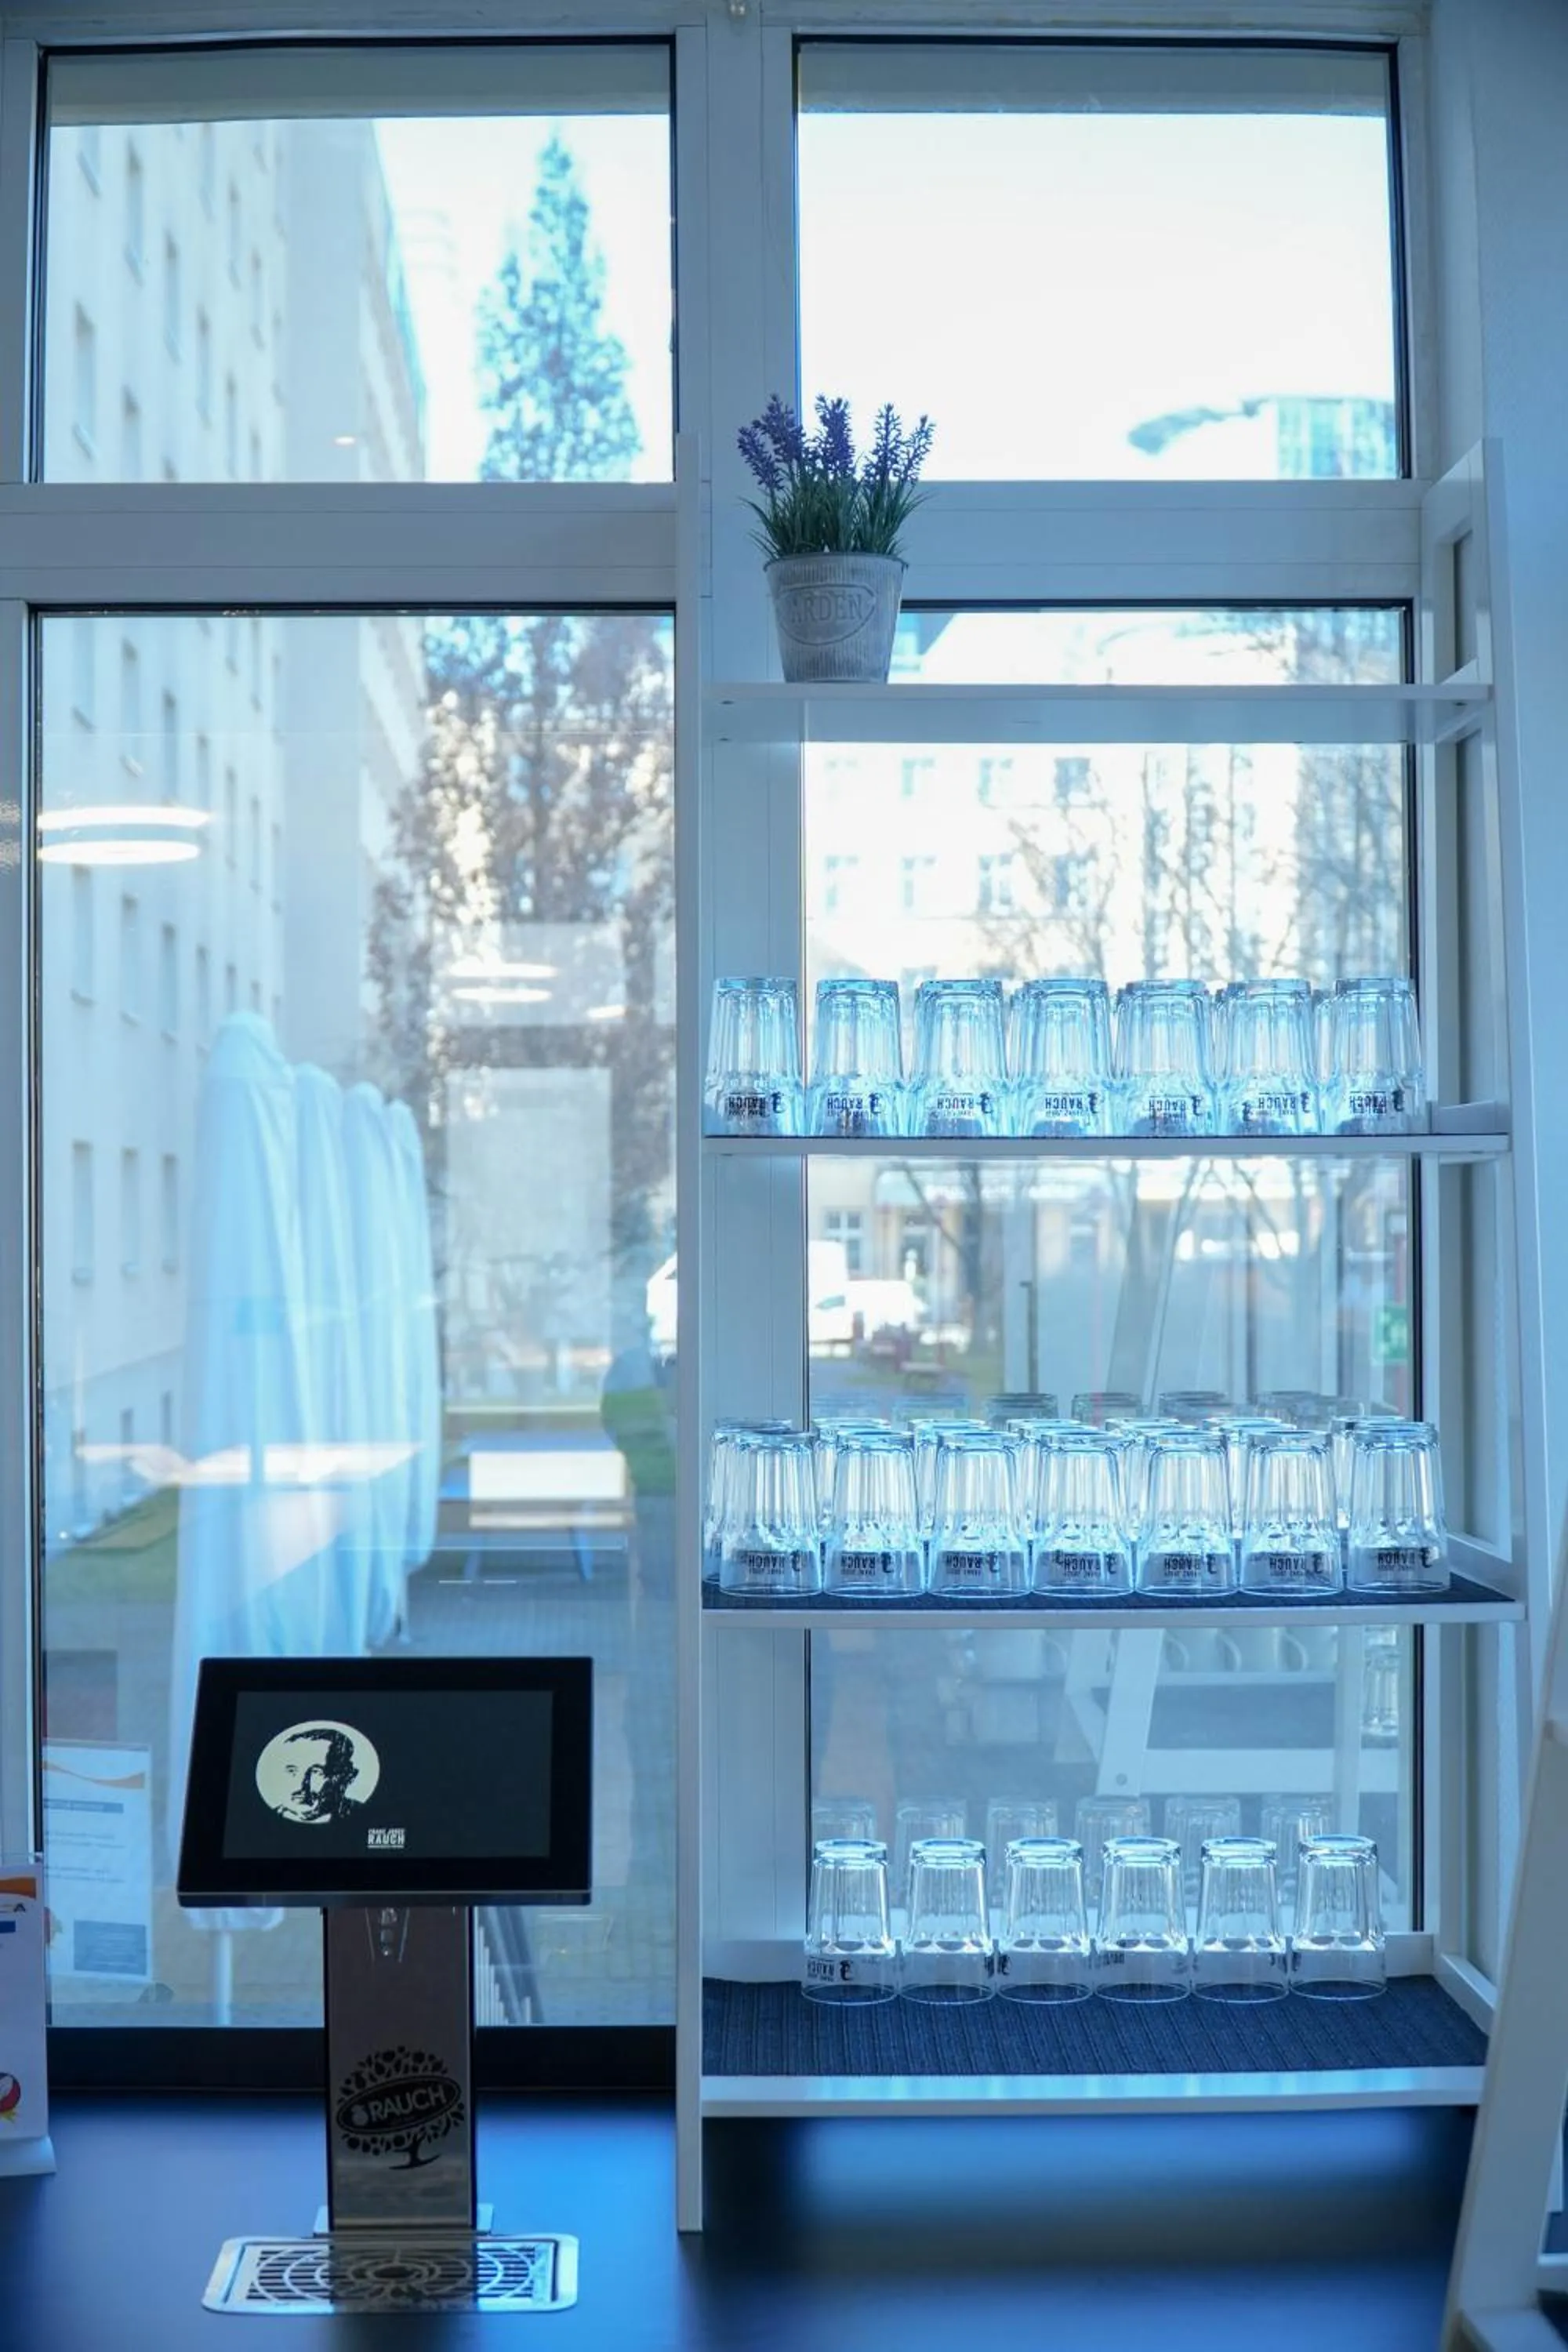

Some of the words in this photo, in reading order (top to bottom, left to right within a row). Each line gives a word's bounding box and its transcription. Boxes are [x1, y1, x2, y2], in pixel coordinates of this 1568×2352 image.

[779, 592, 863, 623] ARDEN
[827, 1098, 863, 1109] RAUCH
[937, 1098, 975, 1109] RAUCH
[1045, 1098, 1083, 1109] RAUCH
[1149, 1099, 1186, 1112] RAUCH
[1258, 1097, 1296, 1109] RAUCH
[841, 1556, 876, 1569] RAUCH
[946, 1555, 981, 1569] RAUCH
[1269, 1558, 1306, 1570] RAUCH
[367, 1834, 405, 1845] RAUCH
[368, 2085, 447, 2122] RAUCH
